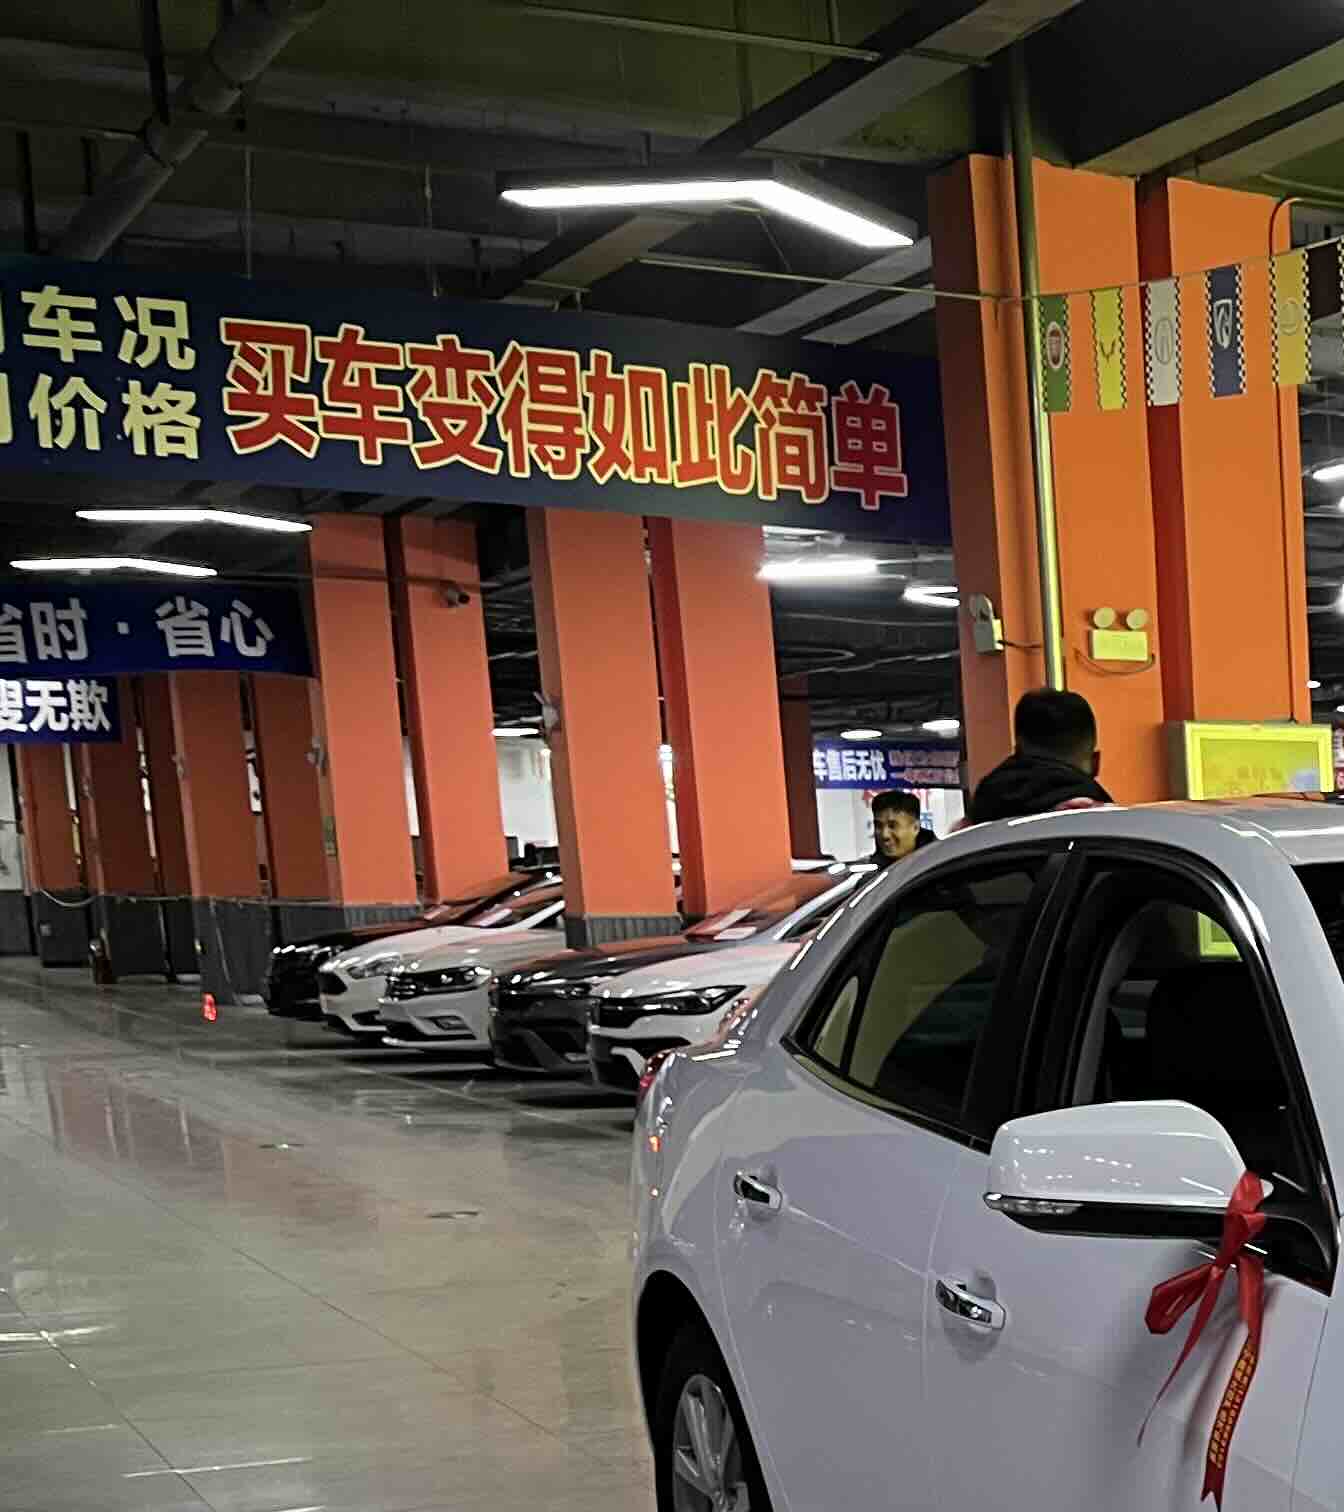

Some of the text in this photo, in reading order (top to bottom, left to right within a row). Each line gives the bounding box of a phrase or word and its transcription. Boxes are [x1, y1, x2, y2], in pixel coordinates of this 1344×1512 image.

[0, 285, 196, 370] 车况
[0, 372, 202, 459] 价格
[219, 317, 909, 511] 买车变得如此简单
